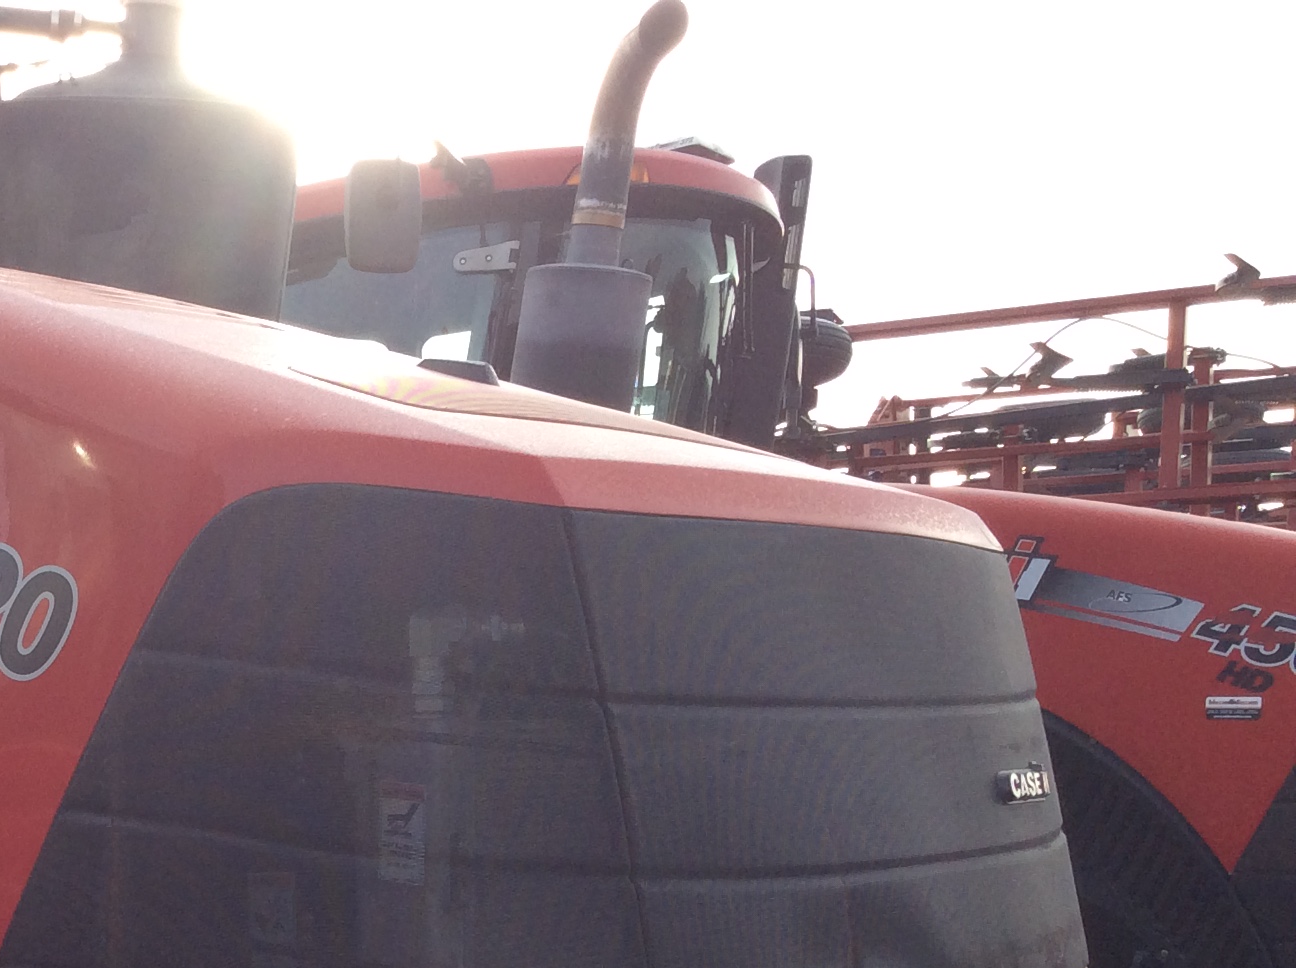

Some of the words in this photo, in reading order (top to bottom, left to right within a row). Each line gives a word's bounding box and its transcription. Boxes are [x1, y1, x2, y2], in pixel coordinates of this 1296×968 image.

[1106, 588, 1133, 604] AFS
[1190, 603, 1296, 675] 45
[1215, 660, 1275, 693] HD
[1010, 771, 1043, 799] CASE
